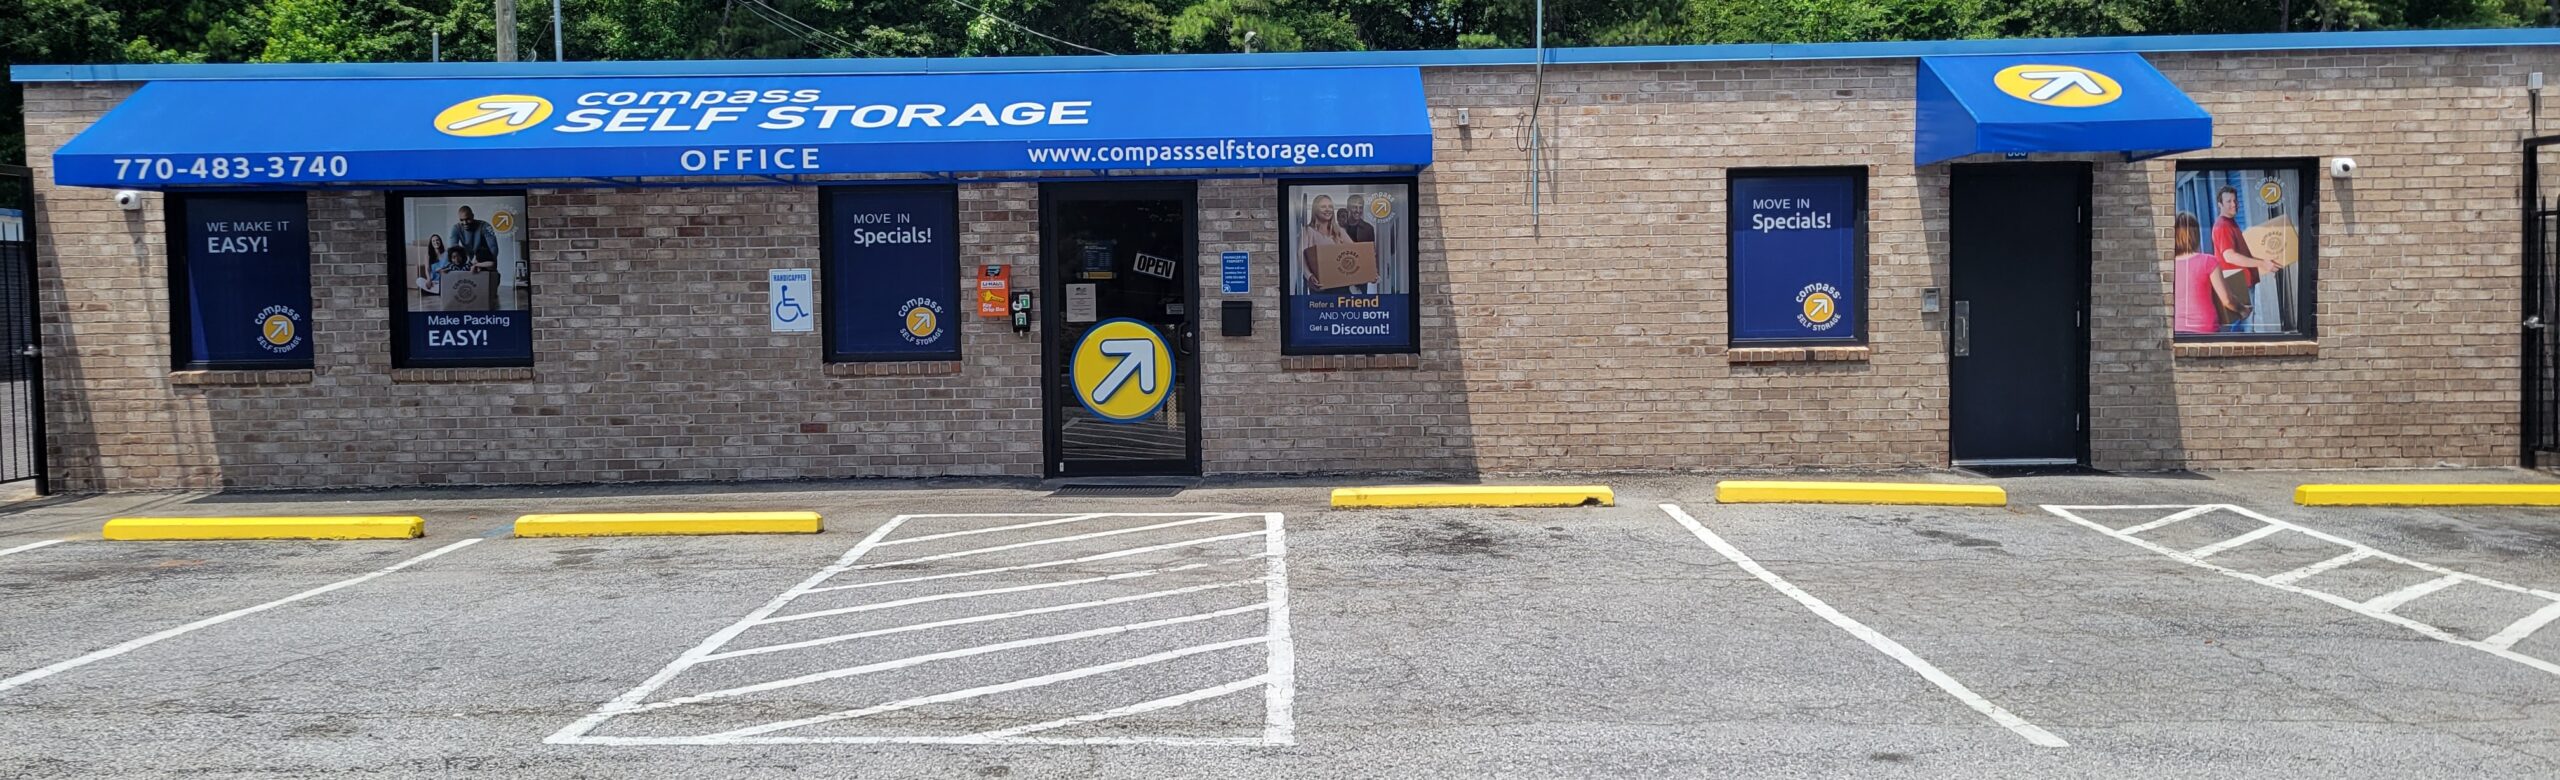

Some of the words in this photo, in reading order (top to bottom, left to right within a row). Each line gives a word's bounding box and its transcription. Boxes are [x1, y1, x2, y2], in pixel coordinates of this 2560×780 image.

[577, 89, 821, 109] compass
[553, 106, 748, 133] SELF
[757, 101, 1092, 130] STORAGE
[680, 148, 820, 171] OFFICE
[1027, 140, 1374, 165] www.compassselfstorage.com
[113, 155, 348, 180] 770-483-3740
[1752, 199, 1791, 210] MOVE
[1797, 198, 1810, 209] IN
[206, 222, 229, 233] WE
[233, 221, 273, 232] MAKE
[278, 221, 290, 231] IT
[853, 213, 891, 224] MOVE
[897, 213, 910, 224] IN
[1752, 211, 1832, 233] Specials!
[207, 236, 269, 254] EASY!
[853, 226, 932, 247] Specials!
[1136, 255, 1173, 278] OPEN
[773, 274, 807, 282] HANDICAPPED
[1795, 282, 1840, 303] compass
[898, 297, 942, 317] compass
[1309, 301, 1328, 309] Refer
[1337, 295, 1379, 308] Friend
[254, 305, 300, 325] compass
[428, 315, 460, 326] Make
[463, 314, 510, 327] Packing
[1319, 311, 1339, 320] AND
[1341, 311, 1360, 320] YOU
[1362, 311, 1390, 319] BOTH
[1797, 313, 1813, 329] SELF
[1812, 313, 1841, 331] STORAGE
[428, 329, 488, 346] EASY!
[900, 328, 915, 342] SELF
[915, 328, 944, 345] STORAGE
[1309, 324, 1322, 332] Get
[1331, 323, 1390, 335] Discount!
[257, 335, 273, 350] SELF
[272, 335, 302, 353] STORAGE
